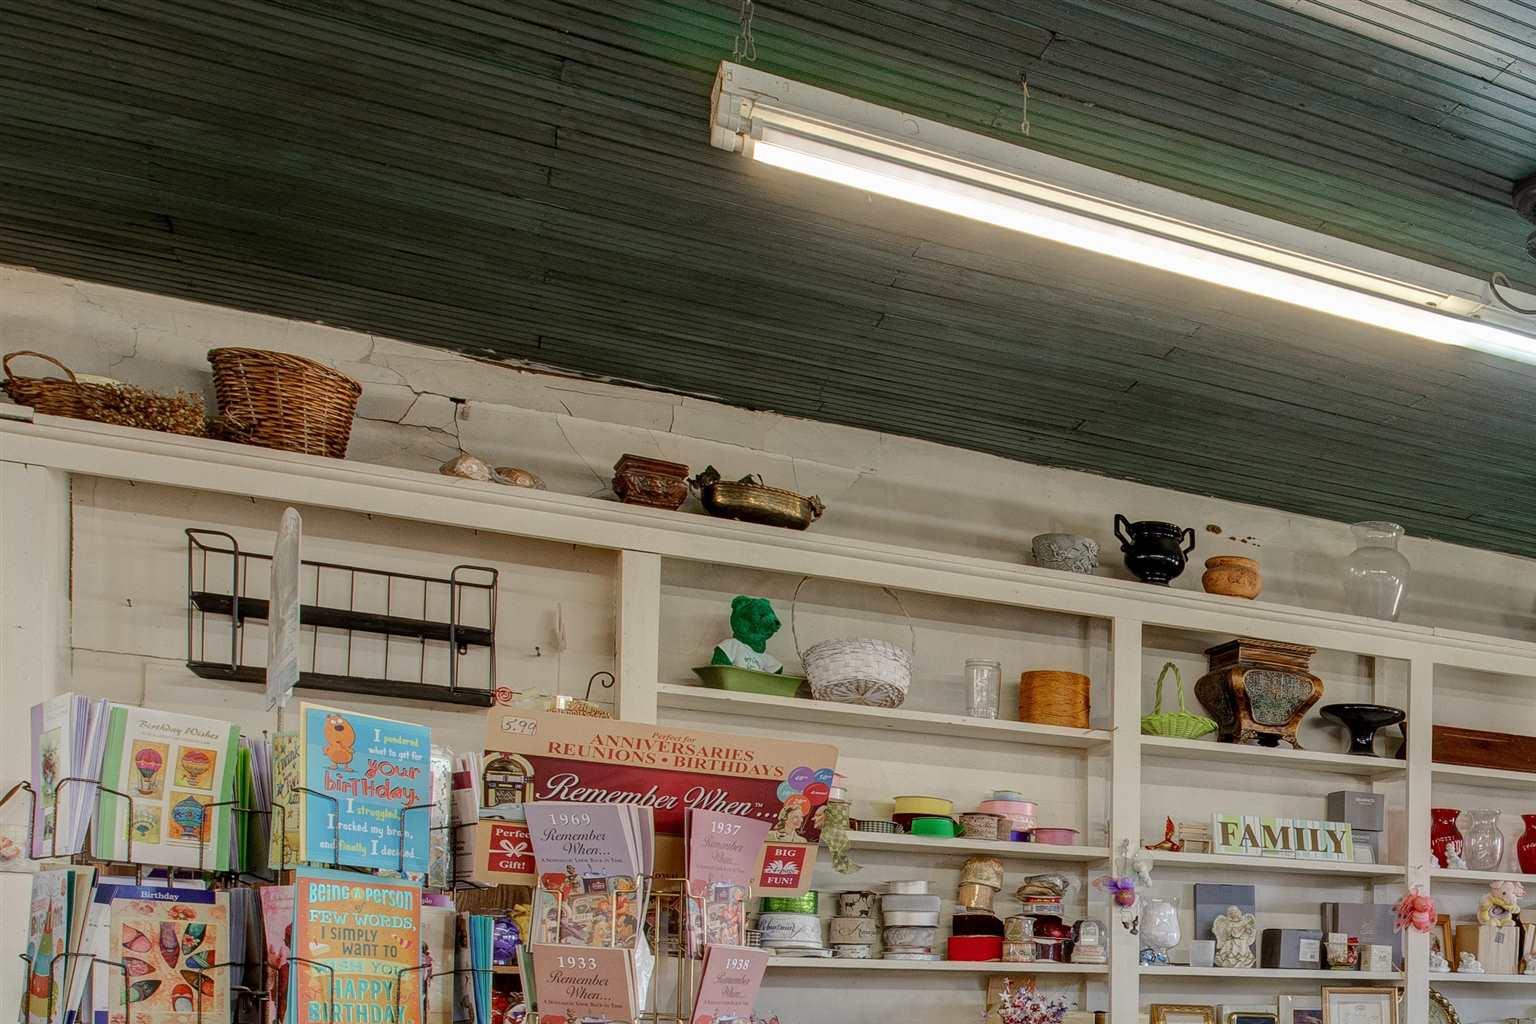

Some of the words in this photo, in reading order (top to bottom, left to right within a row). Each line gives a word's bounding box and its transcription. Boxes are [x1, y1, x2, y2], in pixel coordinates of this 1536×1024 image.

[503, 718, 538, 736] 5.99
[652, 730, 681, 744] Perfect
[683, 735, 697, 744] for
[589, 733, 756, 763] ANNIVERSARIES
[548, 741, 656, 765] REUNIONS
[674, 755, 785, 778] BIRTHDAYS
[535, 773, 681, 811] Remember
[548, 813, 592, 826] 1969
[495, 828, 530, 839] Perfec
[541, 828, 608, 842] Remember
[711, 821, 741, 836] 1937
[1217, 820, 1347, 854] FAMILY
[775, 848, 797, 858] BIG
[499, 860, 526, 870] Gift!
[767, 874, 793, 886] FUN!
[141, 890, 180, 901] Birthday
[309, 909, 349, 925] FEW
[556, 956, 597, 970] 1933
[726, 958, 752, 971] 1938
[546, 970, 609, 986] Remember
[328, 977, 394, 1001] HAPPY
